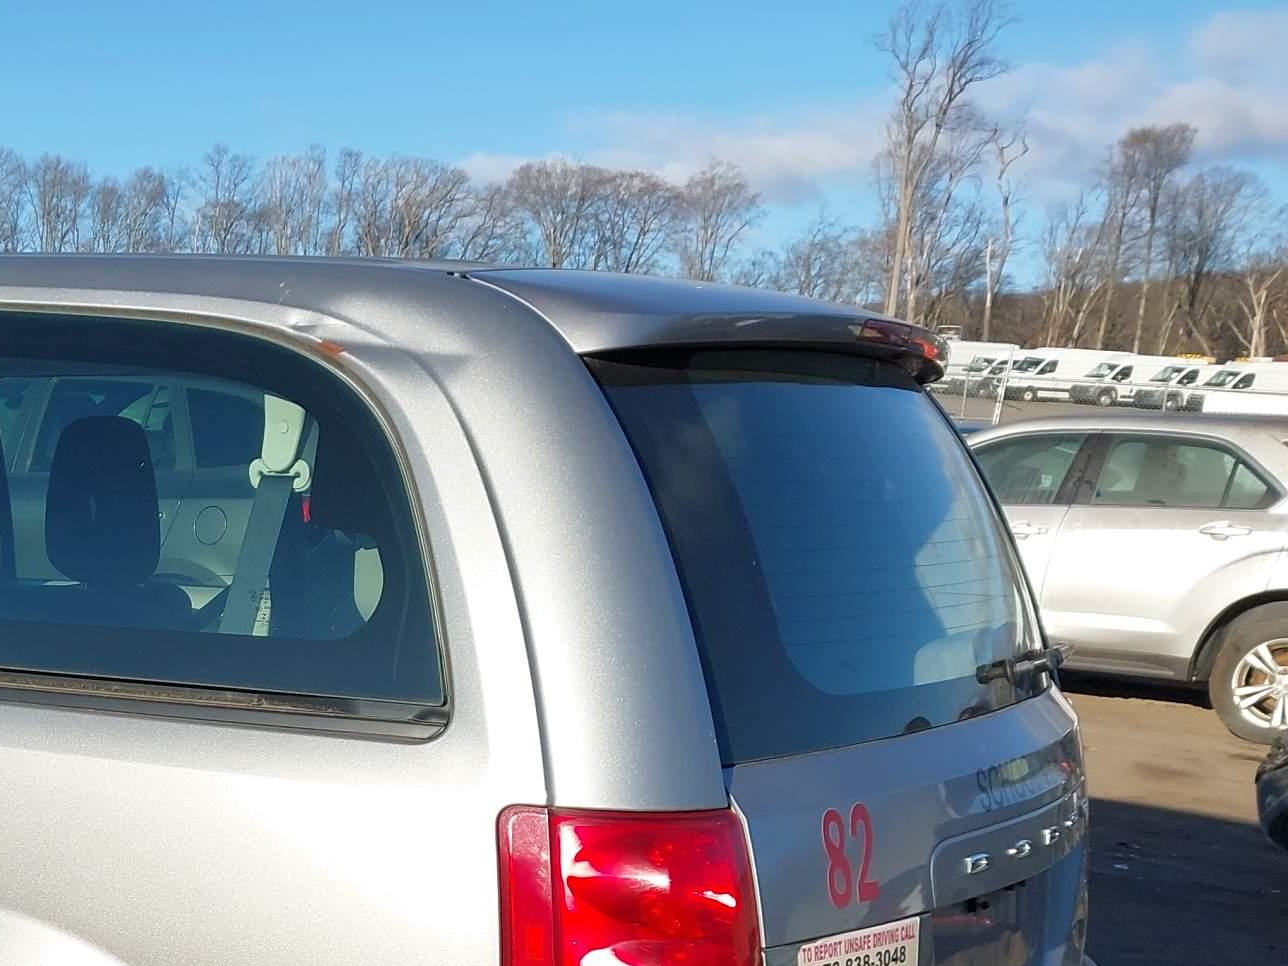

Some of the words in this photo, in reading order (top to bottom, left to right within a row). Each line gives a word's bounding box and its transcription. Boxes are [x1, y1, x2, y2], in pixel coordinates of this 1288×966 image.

[821, 801, 880, 909] 82
[802, 948, 812, 963] TO
[814, 940, 843, 962] REPORT
[844, 934, 871, 954] UNSAFE
[873, 927, 899, 948] DRIVING
[900, 924, 915, 941] CALL
